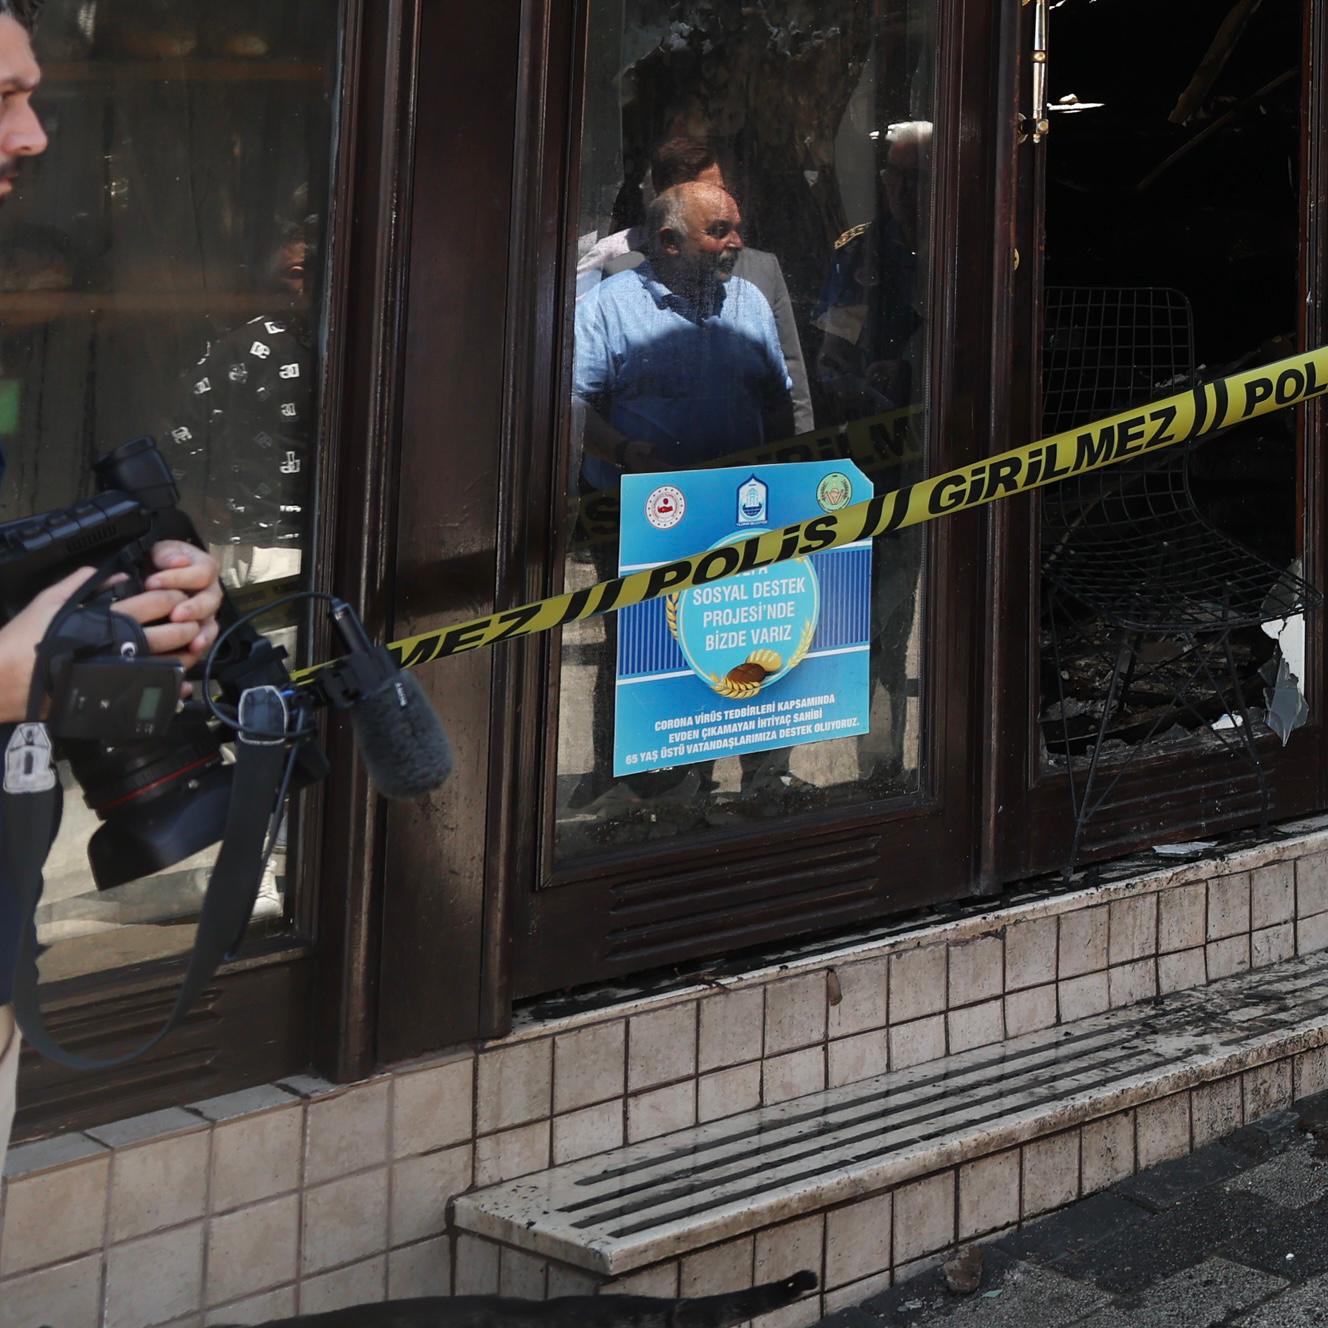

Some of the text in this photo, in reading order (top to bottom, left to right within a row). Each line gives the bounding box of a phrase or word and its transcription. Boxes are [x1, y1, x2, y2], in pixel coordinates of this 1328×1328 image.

[692, 577, 806, 606] SOSYAL DESTEK
[703, 601, 795, 628] PROJESİ'NDE
[705, 624, 792, 651] BİZDE VARIZ
[654, 694, 836, 732] CORONA VİRÜS TEDBİRLERİ KAPSAMINDA
[668, 708, 823, 744] EVDEN ÇIKAMAYAN İHTİYAÇ SAHİBİ
[639, 748, 658, 763] YAŞ
[660, 743, 685, 759] ÜSTÜ
[686, 730, 778, 754] VATANDAŞLARIMIZA
[779, 725, 813, 741] DESTEK
